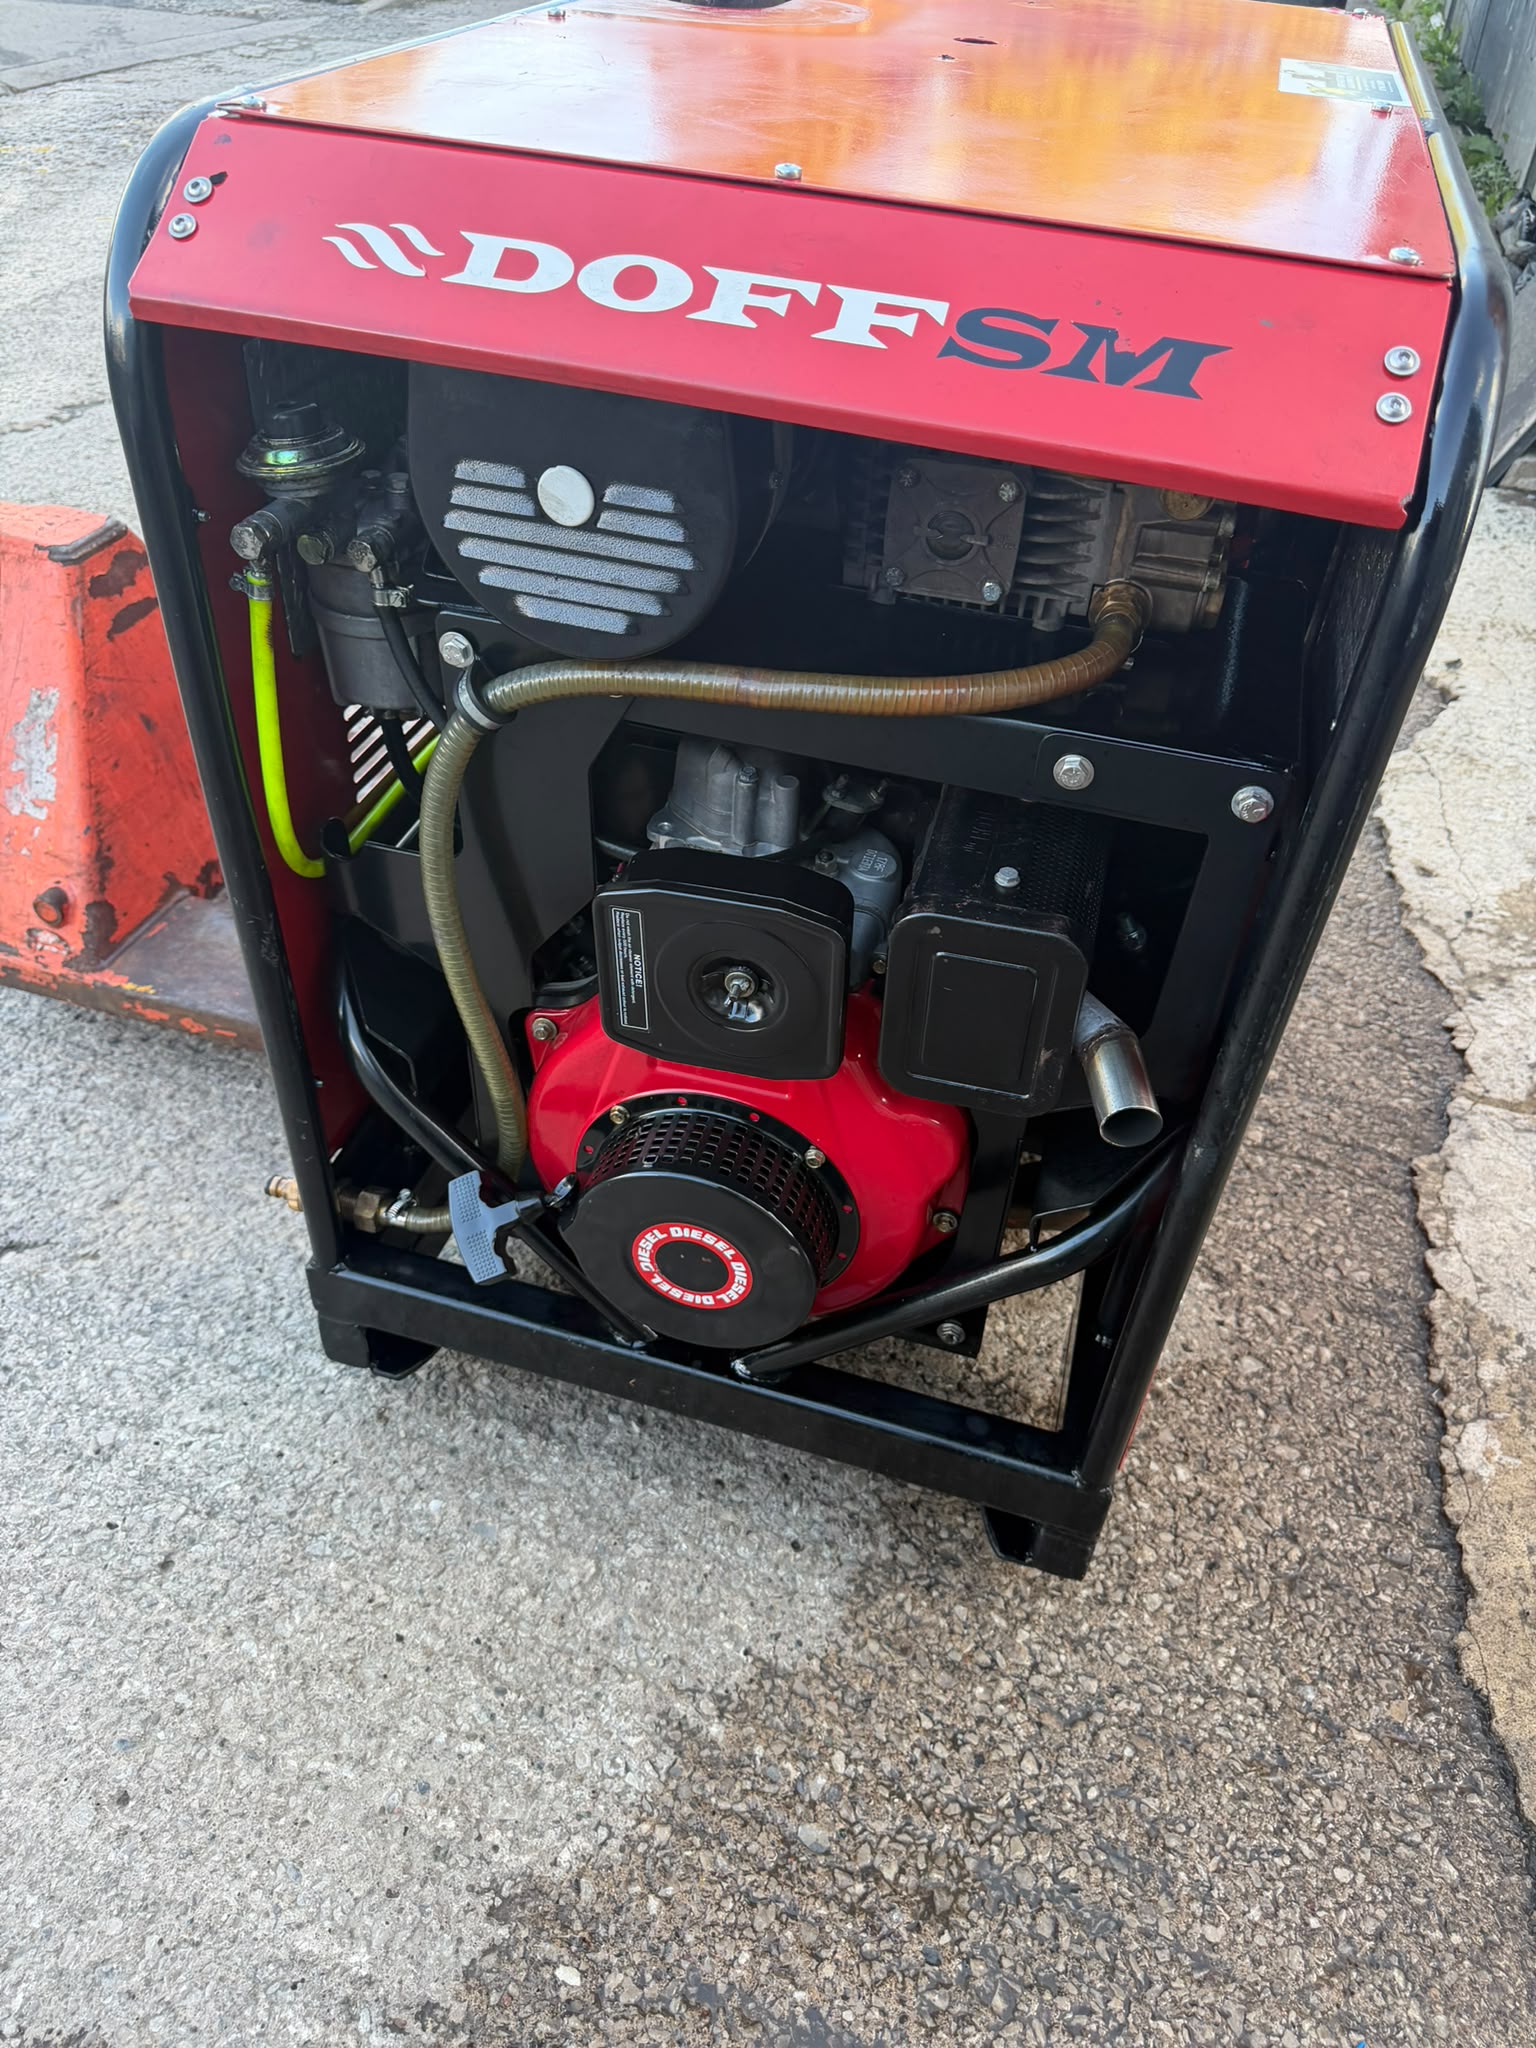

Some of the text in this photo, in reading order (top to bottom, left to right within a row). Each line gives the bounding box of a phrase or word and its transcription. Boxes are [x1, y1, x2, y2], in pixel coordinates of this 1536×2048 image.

[634, 954, 642, 988] NOTICE!
[637, 1229, 668, 1273] DIESEL
[669, 1226, 737, 1260] DIESEL
[649, 1273, 715, 1305] DIESEL
[716, 1261, 748, 1304] DIESEL
